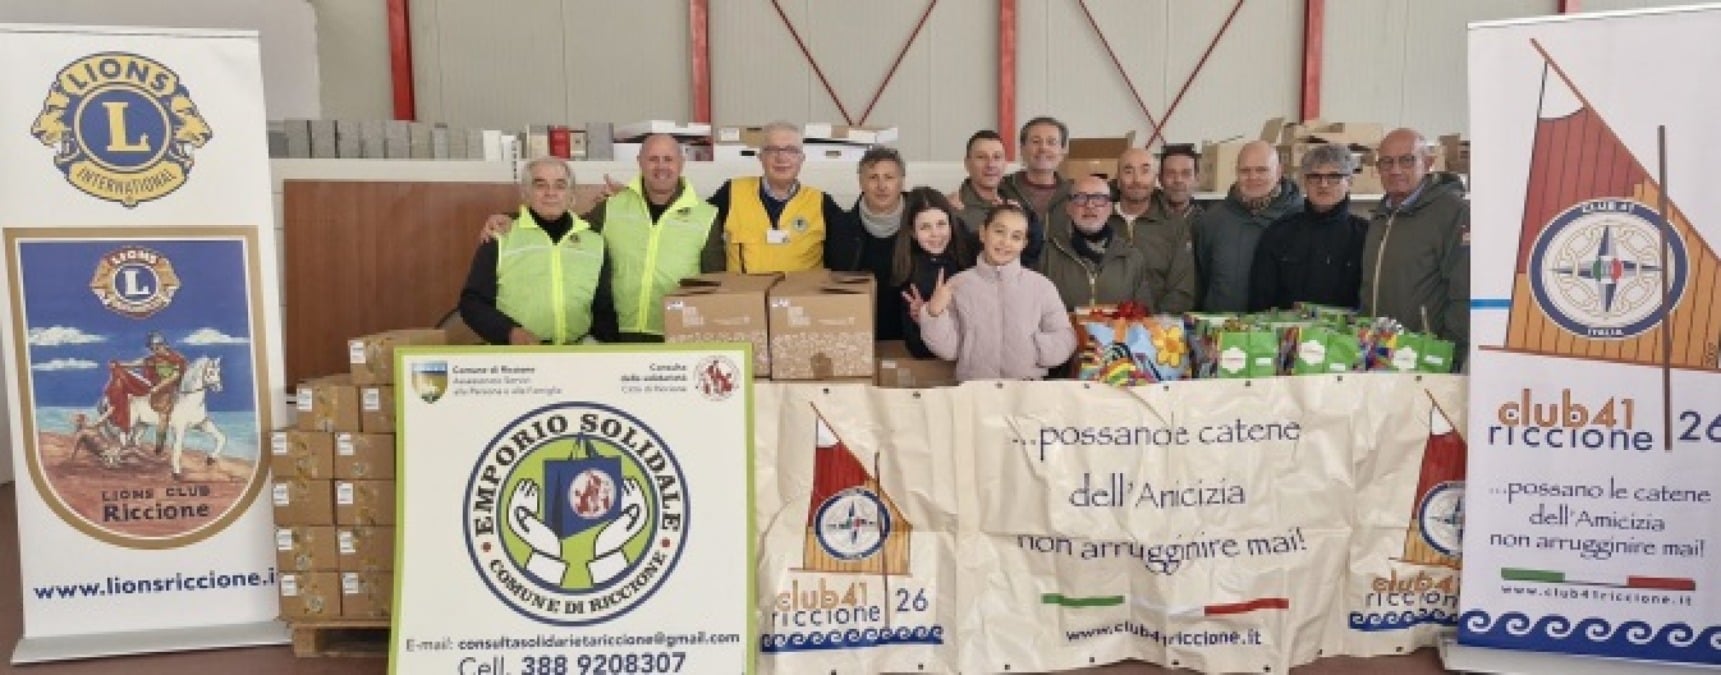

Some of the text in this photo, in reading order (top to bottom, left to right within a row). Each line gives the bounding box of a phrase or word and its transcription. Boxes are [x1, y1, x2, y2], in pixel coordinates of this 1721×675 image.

[67, 58, 169, 91] LIONS
[102, 101, 151, 152] L
[77, 168, 178, 195] INTERNATIONAL
[123, 269, 150, 296] L
[1497, 388, 1636, 430] club41
[1198, 418, 1302, 444] catene
[1487, 425, 1653, 451] riccione
[1678, 410, 1721, 443] 26
[473, 413, 682, 537] EMPORIO SOLIDALE
[102, 485, 210, 502] LIONS CLUB
[1610, 477, 1629, 500] le
[1633, 484, 1711, 504] catene
[103, 503, 210, 523] Riccione
[1528, 503, 1665, 531] dell'Amicizia
[1017, 526, 1307, 576] non arrugginire mai!
[1490, 533, 1705, 560] non arrugginire mai!
[489, 550, 668, 614] COMUNE DI RICCIONE
[775, 577, 868, 612] club41
[1501, 584, 1693, 607] www.club41riccione.it
[896, 587, 929, 613] 26
[1366, 592, 1459, 609] riccion
[772, 604, 881, 628] riccione
[406, 631, 741, 652] E-mail: consultasolidarietariccione@gmail.com
[1065, 620, 1262, 647] www.club41riccione.it
[458, 651, 687, 675] Cell. 388 9208307
